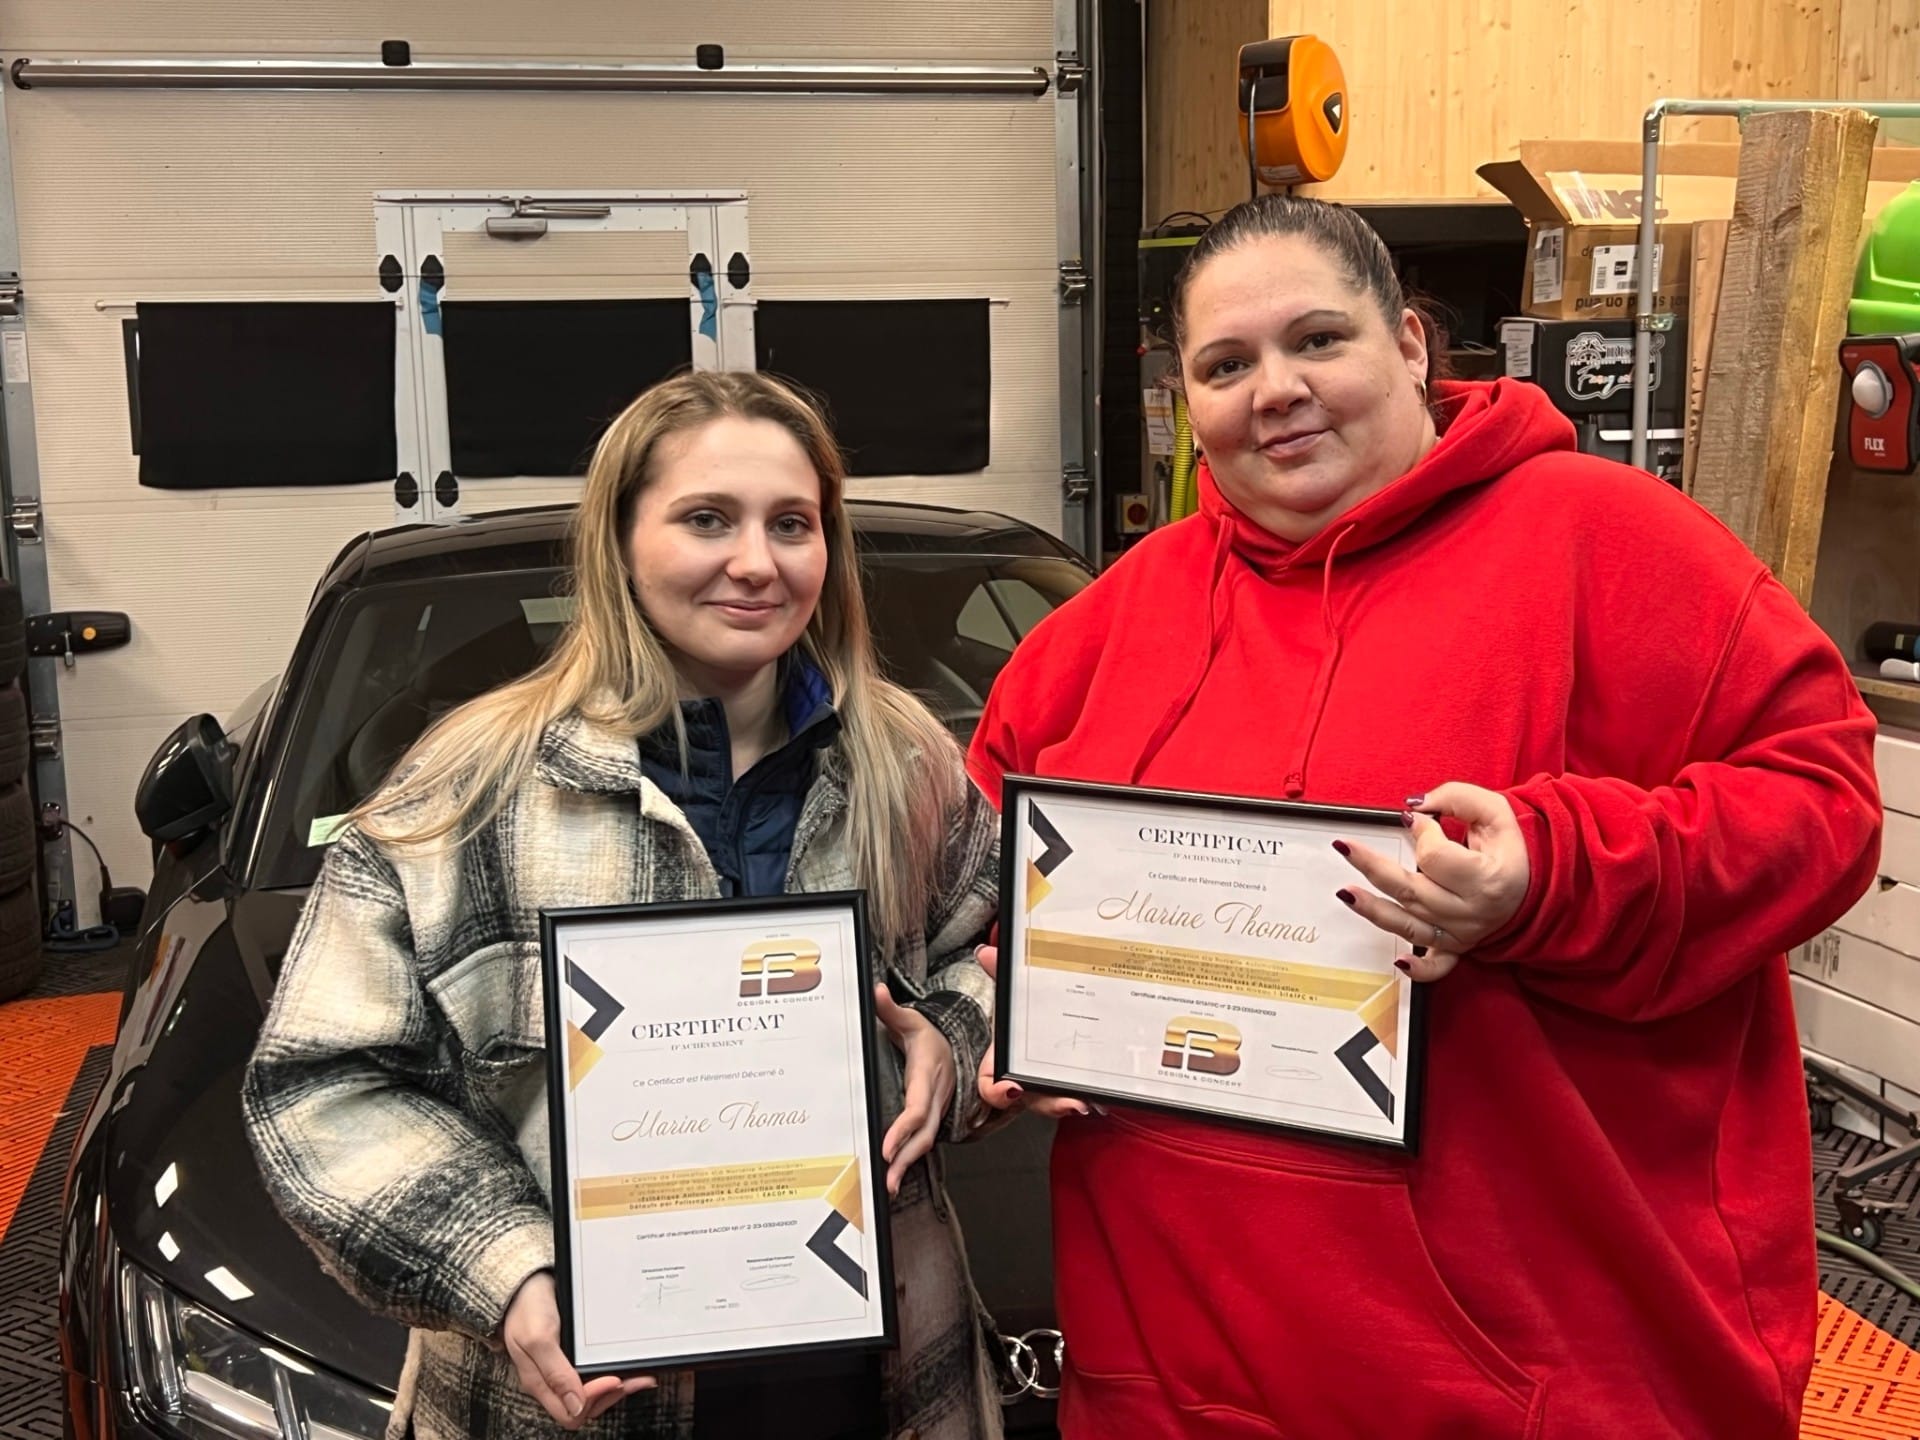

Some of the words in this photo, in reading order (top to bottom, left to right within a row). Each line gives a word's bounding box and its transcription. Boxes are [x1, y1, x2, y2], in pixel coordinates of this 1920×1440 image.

[1606, 297, 1623, 308] on
[1864, 437, 1885, 450] FLEX
[1138, 827, 1284, 856] CERTIFICAT
[1097, 890, 1205, 930] Marine
[1214, 901, 1321, 944] Thomas
[737, 998, 771, 1007] DESIGN
[783, 995, 825, 1003] CONCEPT
[631, 1014, 785, 1040] CERTIFICAT
[632, 1079, 645, 1088] Ce
[646, 1075, 684, 1087] Certificat
[686, 1075, 698, 1083] est
[1158, 1070, 1190, 1080] DESIGN
[1200, 1076, 1242, 1088] CONCEPT
[611, 1109, 712, 1142] Marine
[719, 1101, 811, 1131] Thomas
